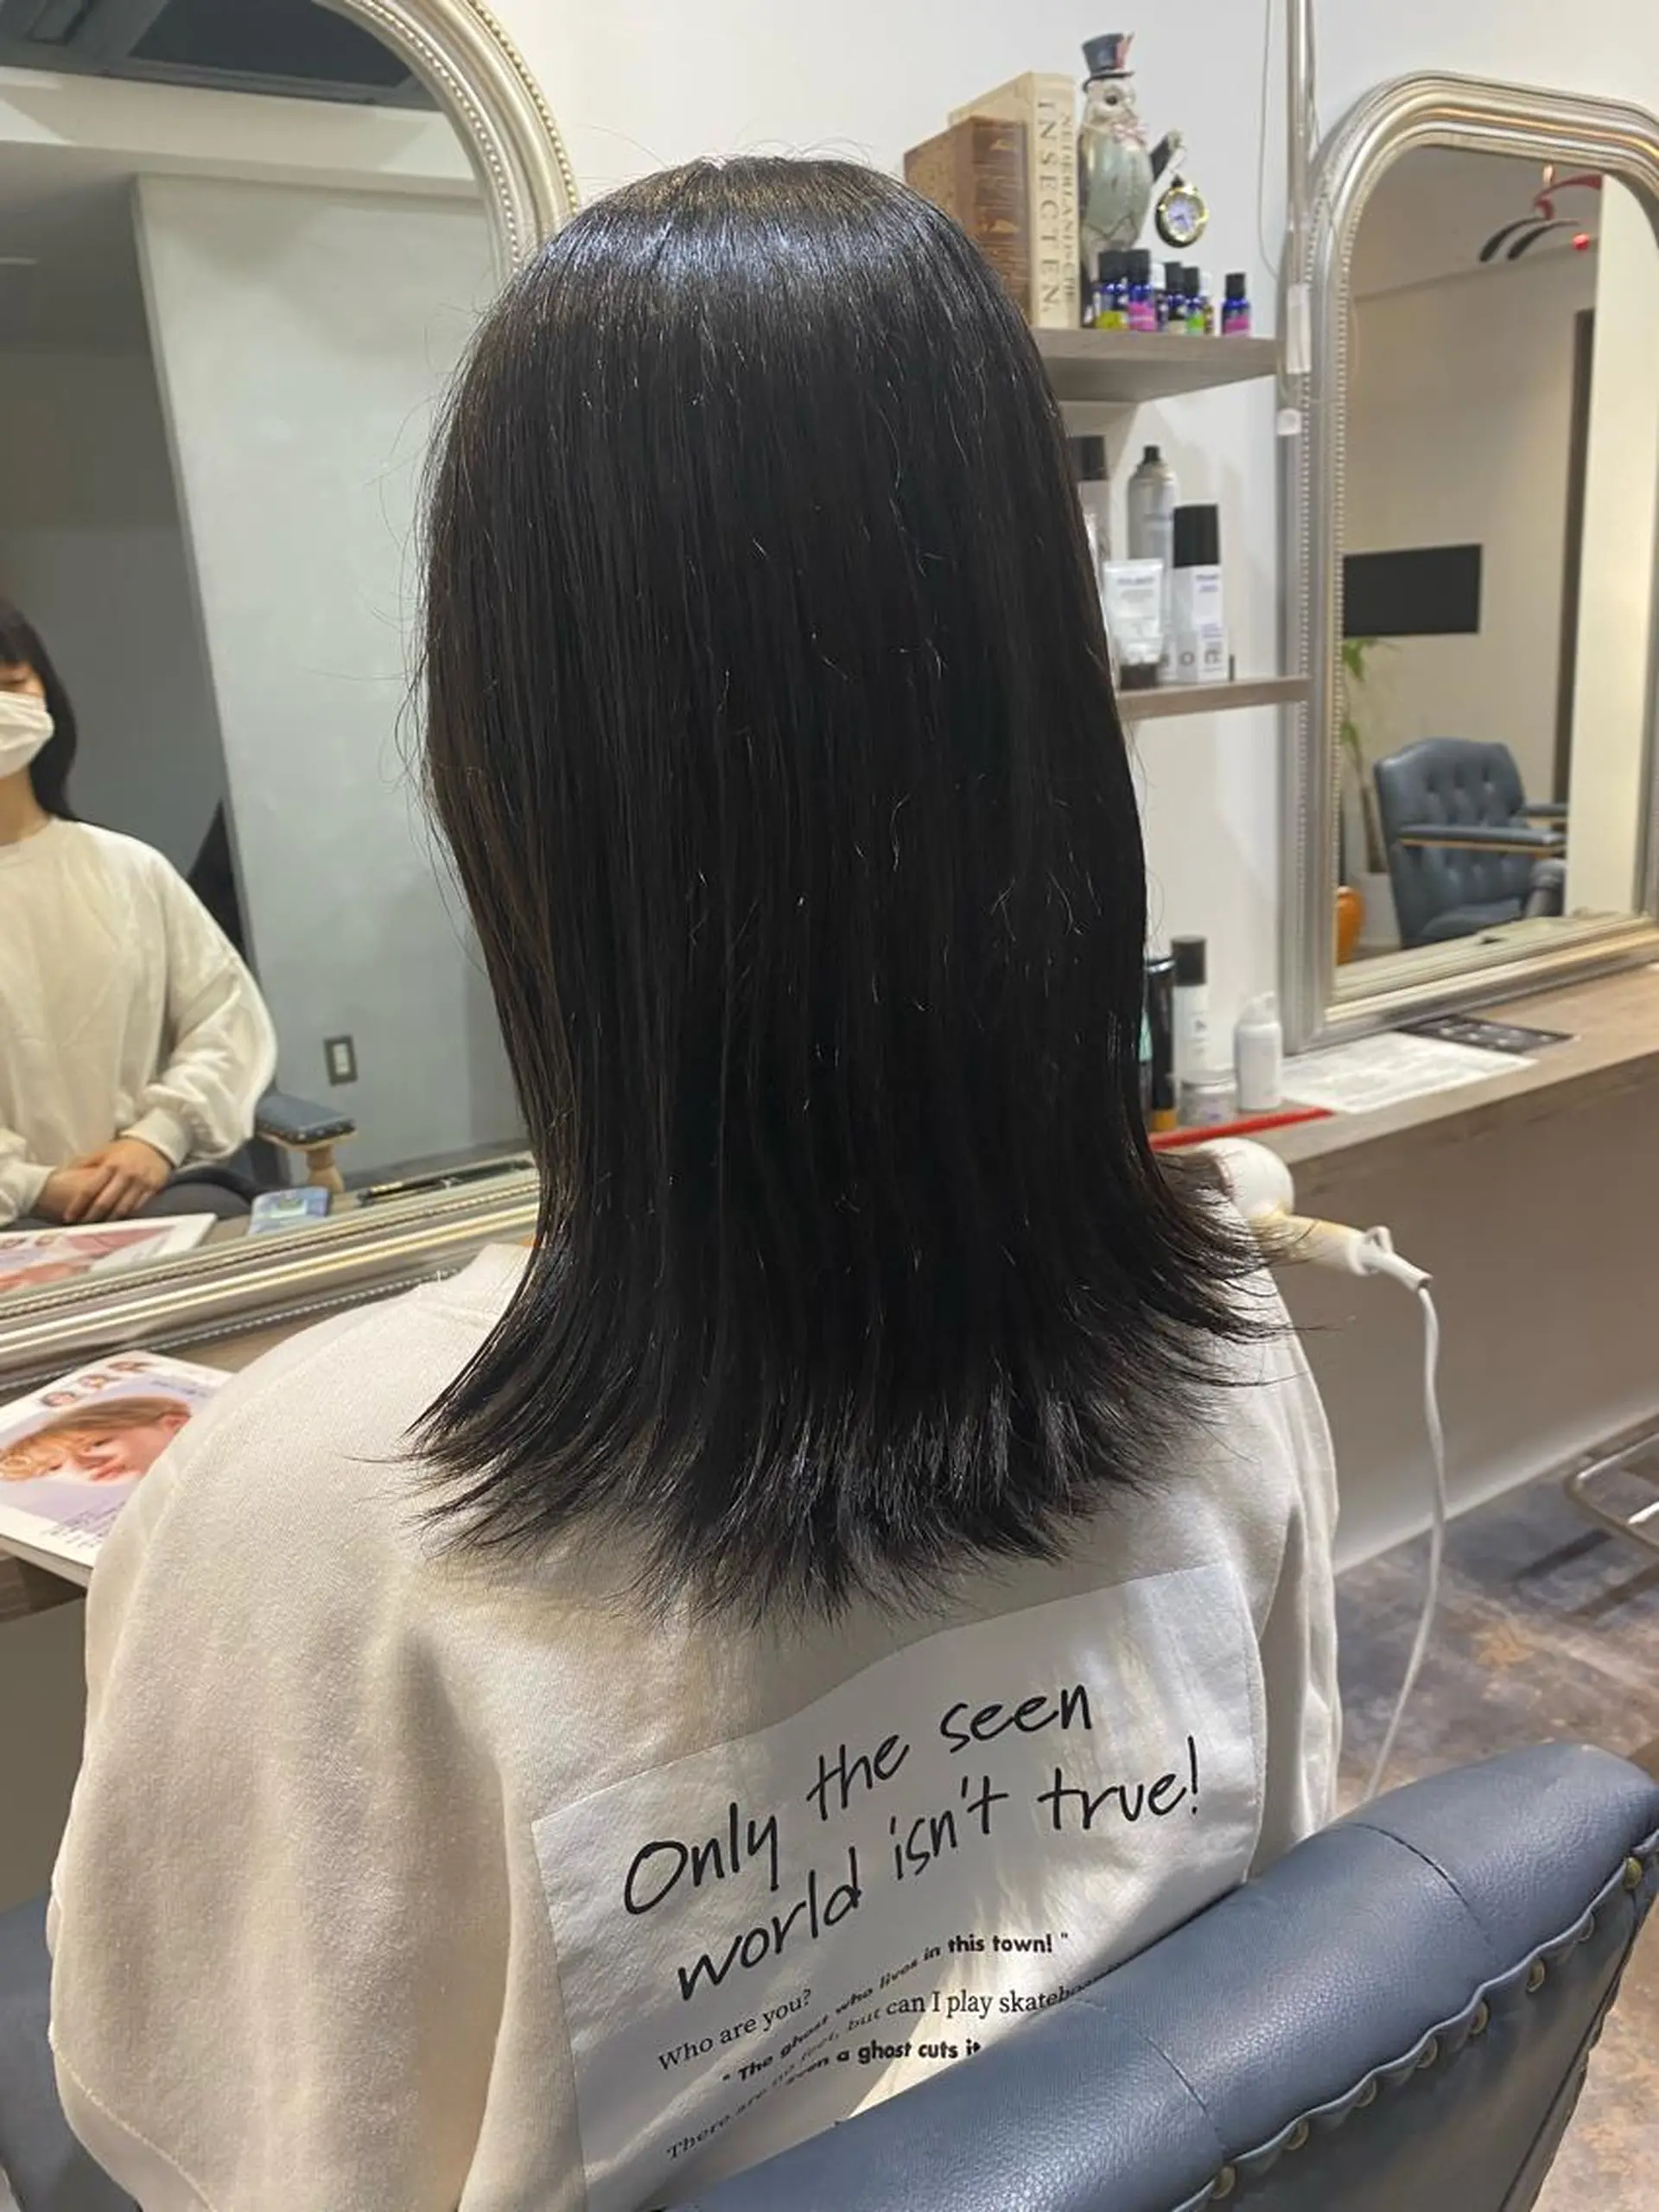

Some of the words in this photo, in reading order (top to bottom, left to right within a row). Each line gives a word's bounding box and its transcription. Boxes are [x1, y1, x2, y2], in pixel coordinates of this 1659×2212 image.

[625, 1802, 779, 1915] Only
[806, 1734, 910, 1821] the
[940, 1684, 1091, 1753] seen
[677, 1846, 861, 2001] world
[890, 1775, 1009, 1880] isn't
[1037, 1735, 1198, 1830] true!
[658, 2037, 714, 2071] Who
[719, 2017, 757, 2044] are
[763, 1988, 811, 2031] you?
[737, 2056, 774, 2082] The
[835, 1987, 874, 2014] who
[923, 1944, 941, 1961] in
[947, 1934, 985, 1953] this
[993, 1934, 1052, 1953] town!
[836, 2050, 850, 2063] a
[857, 2039, 912, 2065] ghost
[918, 2040, 959, 2059] cuts
[886, 1996, 925, 2016] can
[931, 1991, 941, 2012] I
[945, 1989, 994, 2020] play
